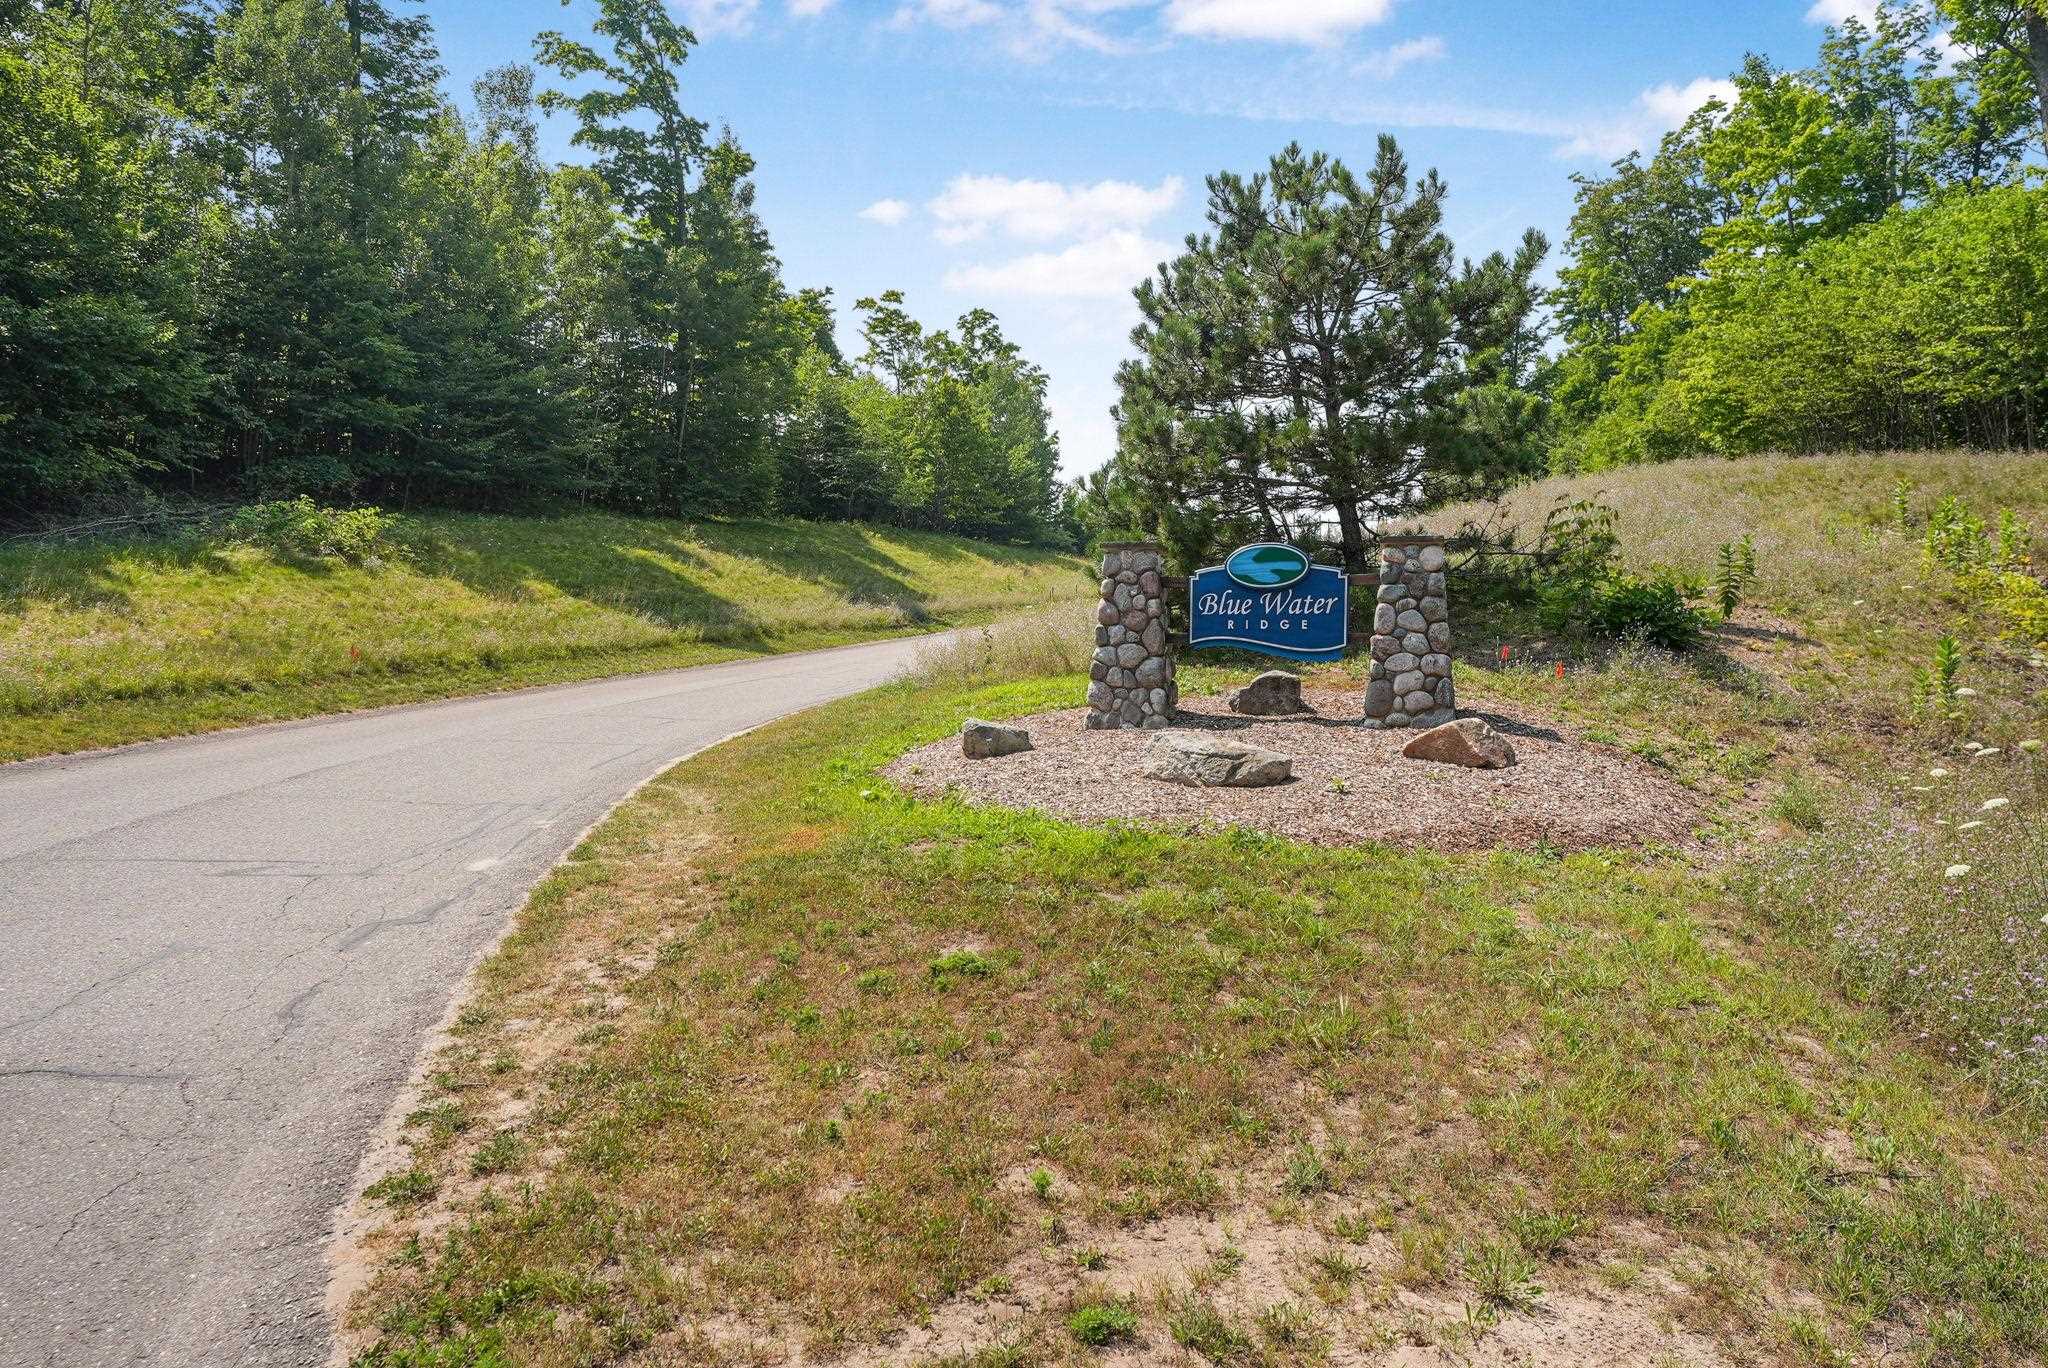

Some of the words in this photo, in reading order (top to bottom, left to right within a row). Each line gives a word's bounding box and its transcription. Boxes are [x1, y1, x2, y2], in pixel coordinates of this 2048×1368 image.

[1198, 589, 1253, 615] Blue
[1260, 589, 1338, 615] Water
[1227, 619, 1308, 630] RIDGE
